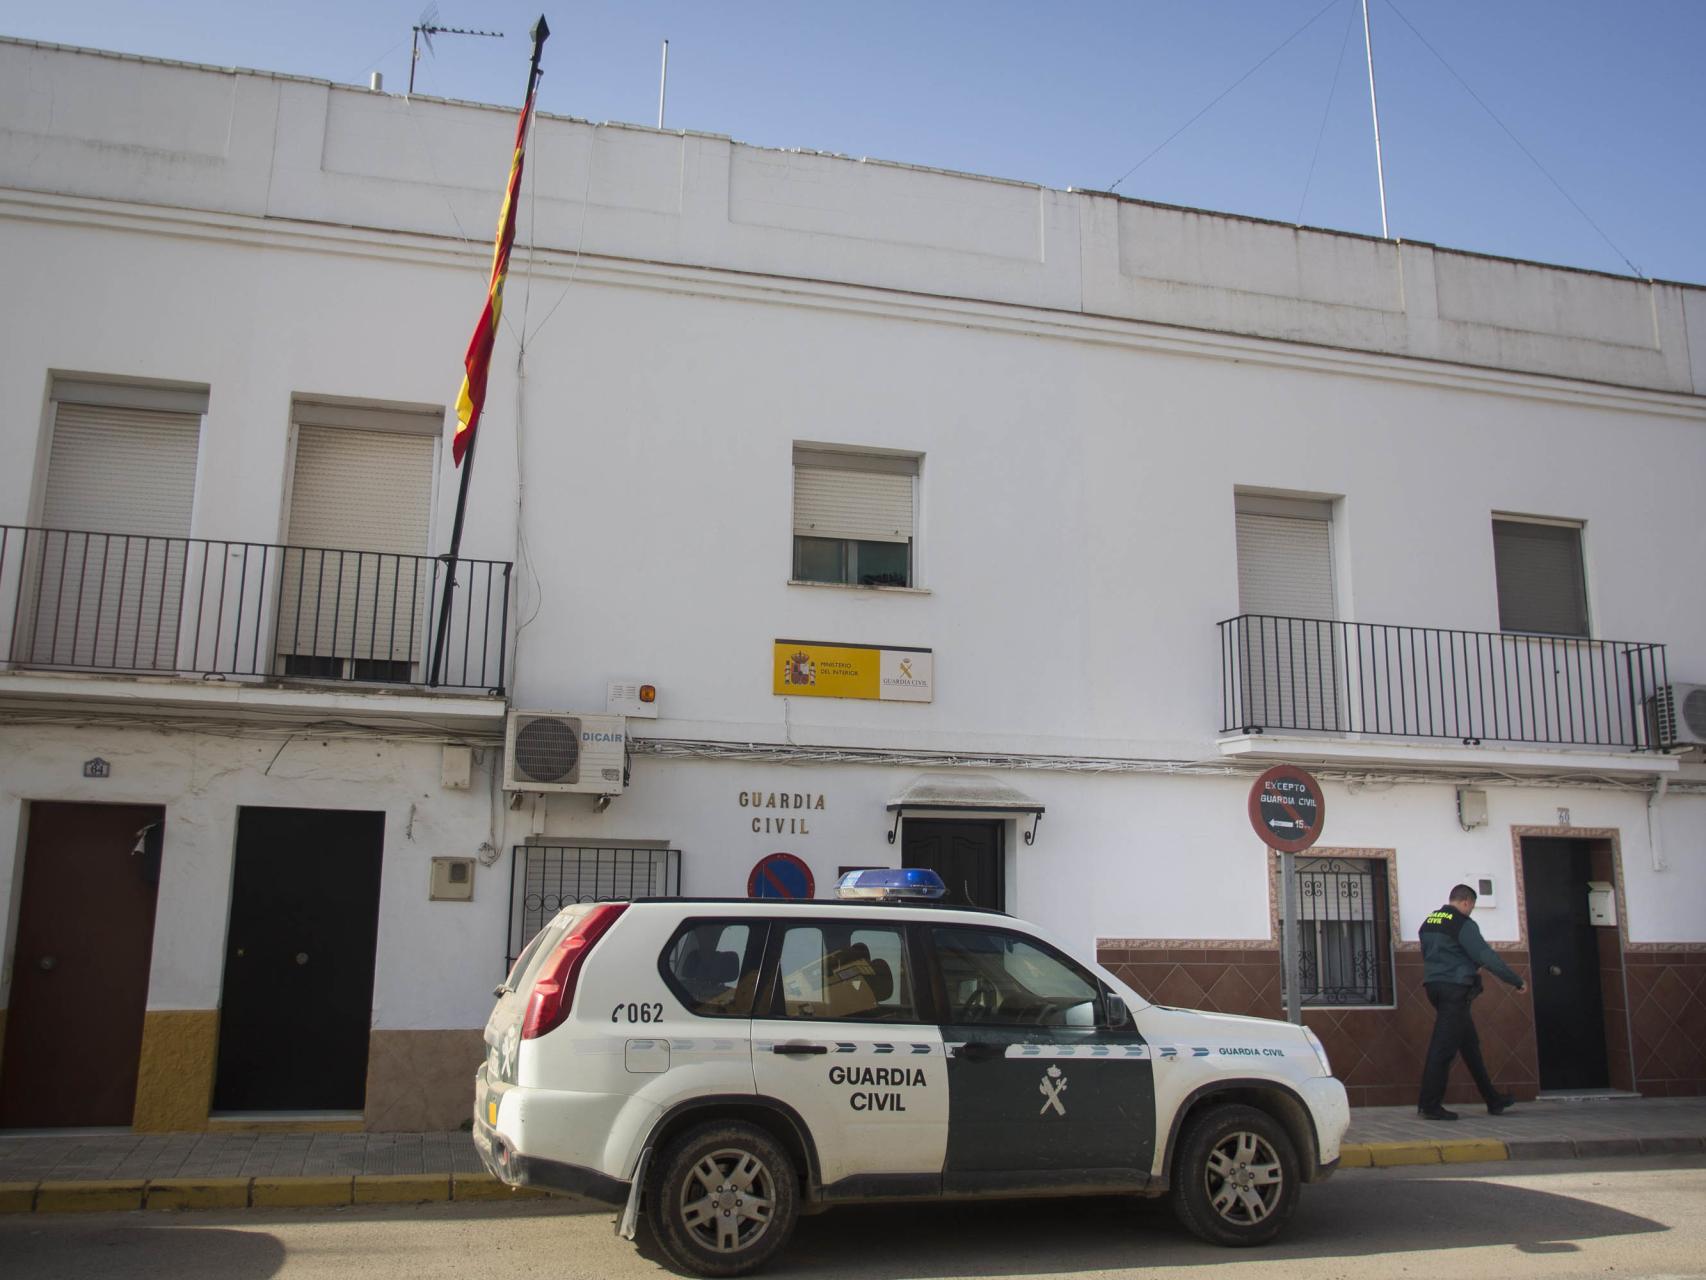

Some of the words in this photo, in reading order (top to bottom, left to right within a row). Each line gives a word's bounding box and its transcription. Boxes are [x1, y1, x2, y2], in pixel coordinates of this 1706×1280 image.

[582, 733, 624, 742] DICAIR
[1265, 781, 1305, 792] EXCEPTO
[739, 791, 825, 810] GUARDIA
[1260, 794, 1295, 805] GUARDIA
[1298, 797, 1316, 807] CIVIL
[751, 817, 809, 835] CIVIL
[628, 1002, 664, 1023] 062
[1219, 1047, 1261, 1056] GUARDIA
[1262, 1048, 1285, 1057] CIVIL
[828, 1066, 927, 1086] GUARDIA
[849, 1092, 906, 1111] CIVIL
